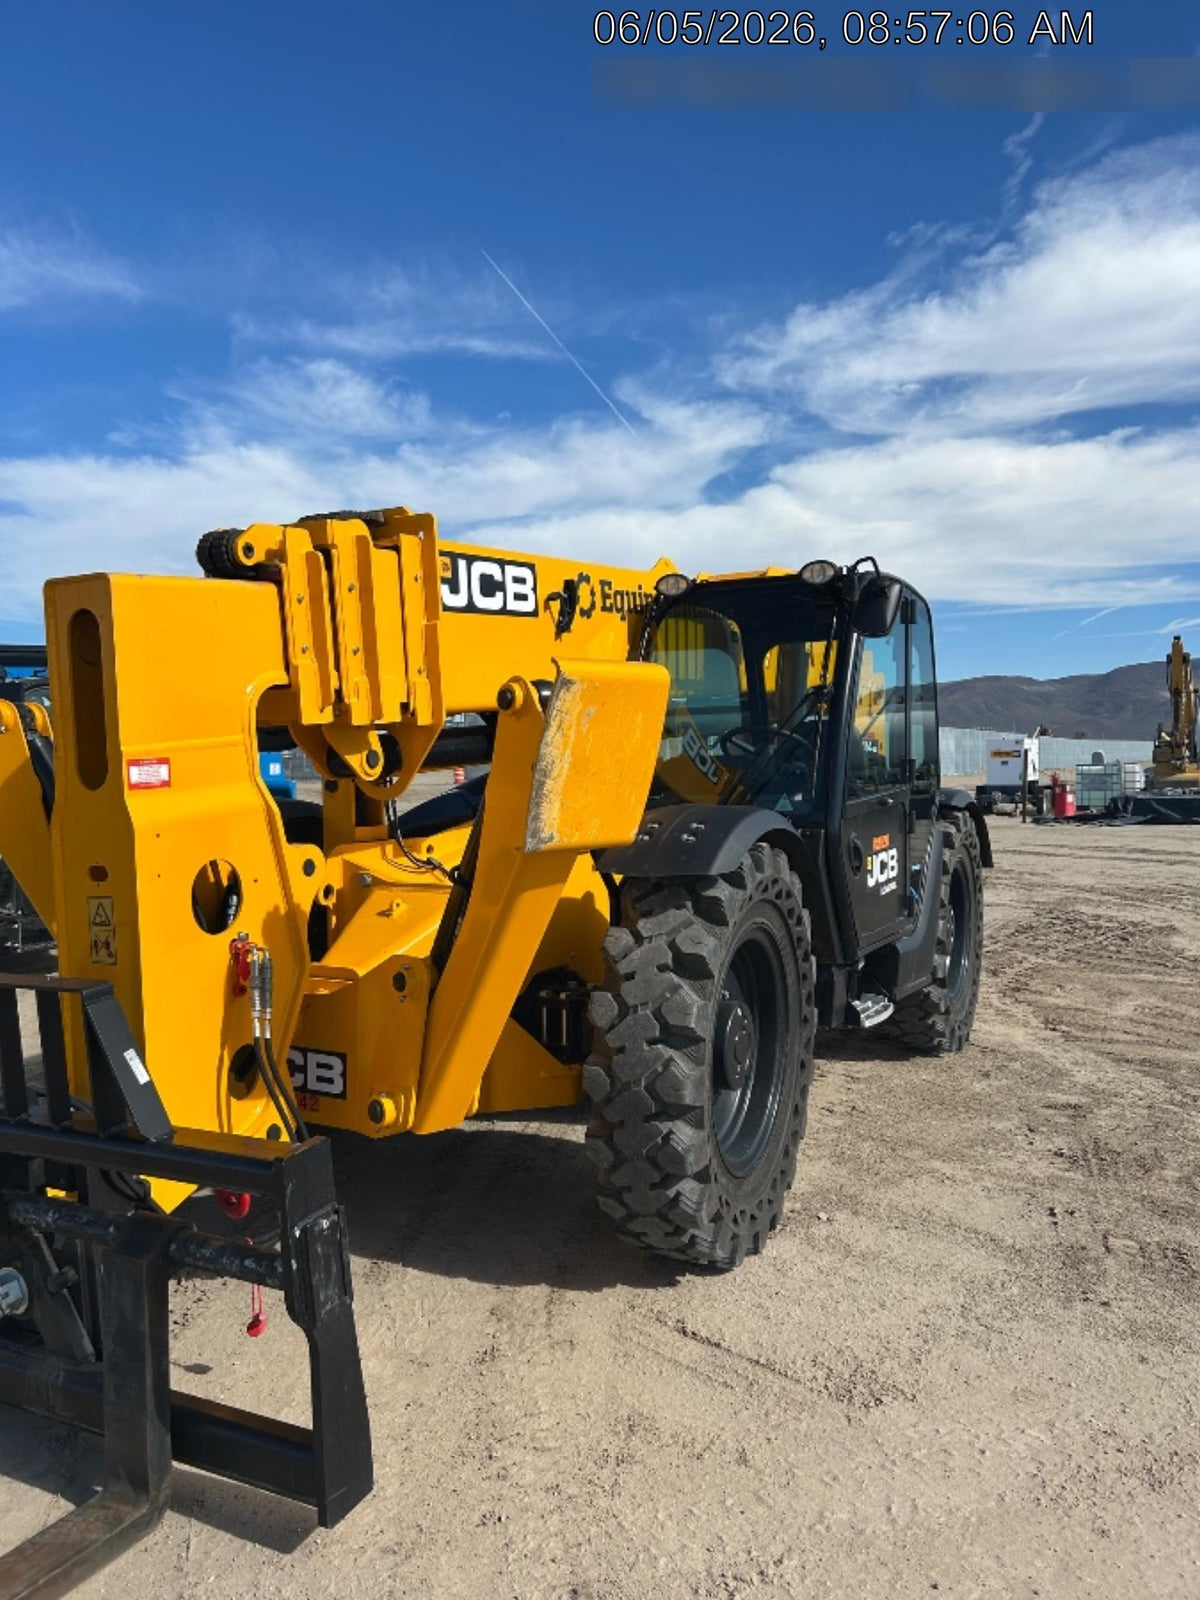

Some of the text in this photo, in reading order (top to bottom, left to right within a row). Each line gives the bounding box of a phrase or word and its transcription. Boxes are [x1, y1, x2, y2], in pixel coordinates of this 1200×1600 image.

[441, 558, 536, 612] JCB
[867, 847, 898, 888] JCB
[295, 1094, 319, 1111] 42
